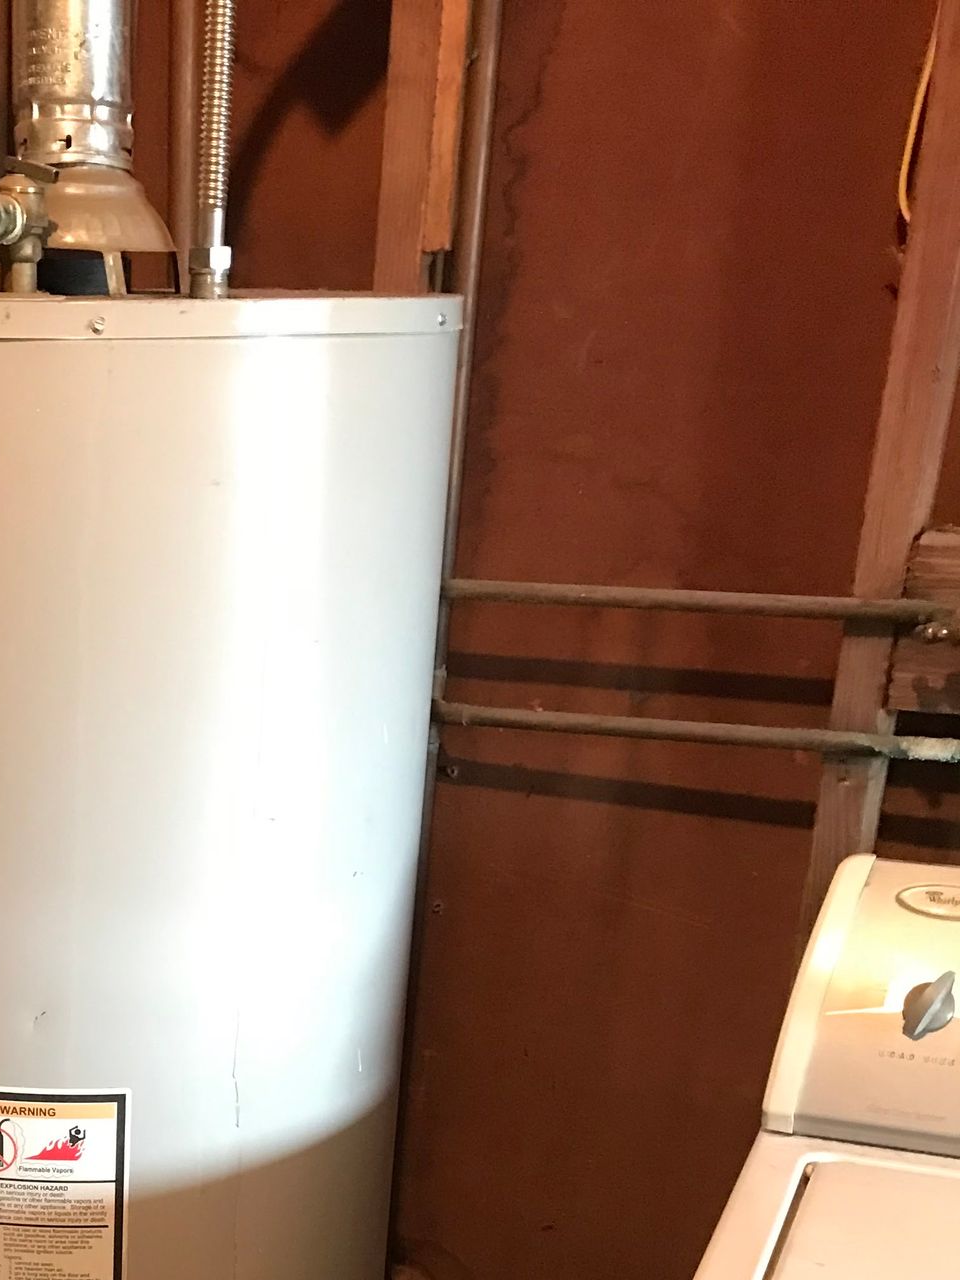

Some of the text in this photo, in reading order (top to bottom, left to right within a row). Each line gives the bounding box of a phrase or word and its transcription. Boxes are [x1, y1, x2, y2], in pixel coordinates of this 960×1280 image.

[0, 1105, 57, 1117] WARNING
[18, 1166, 74, 1175] Flammable Vapors
